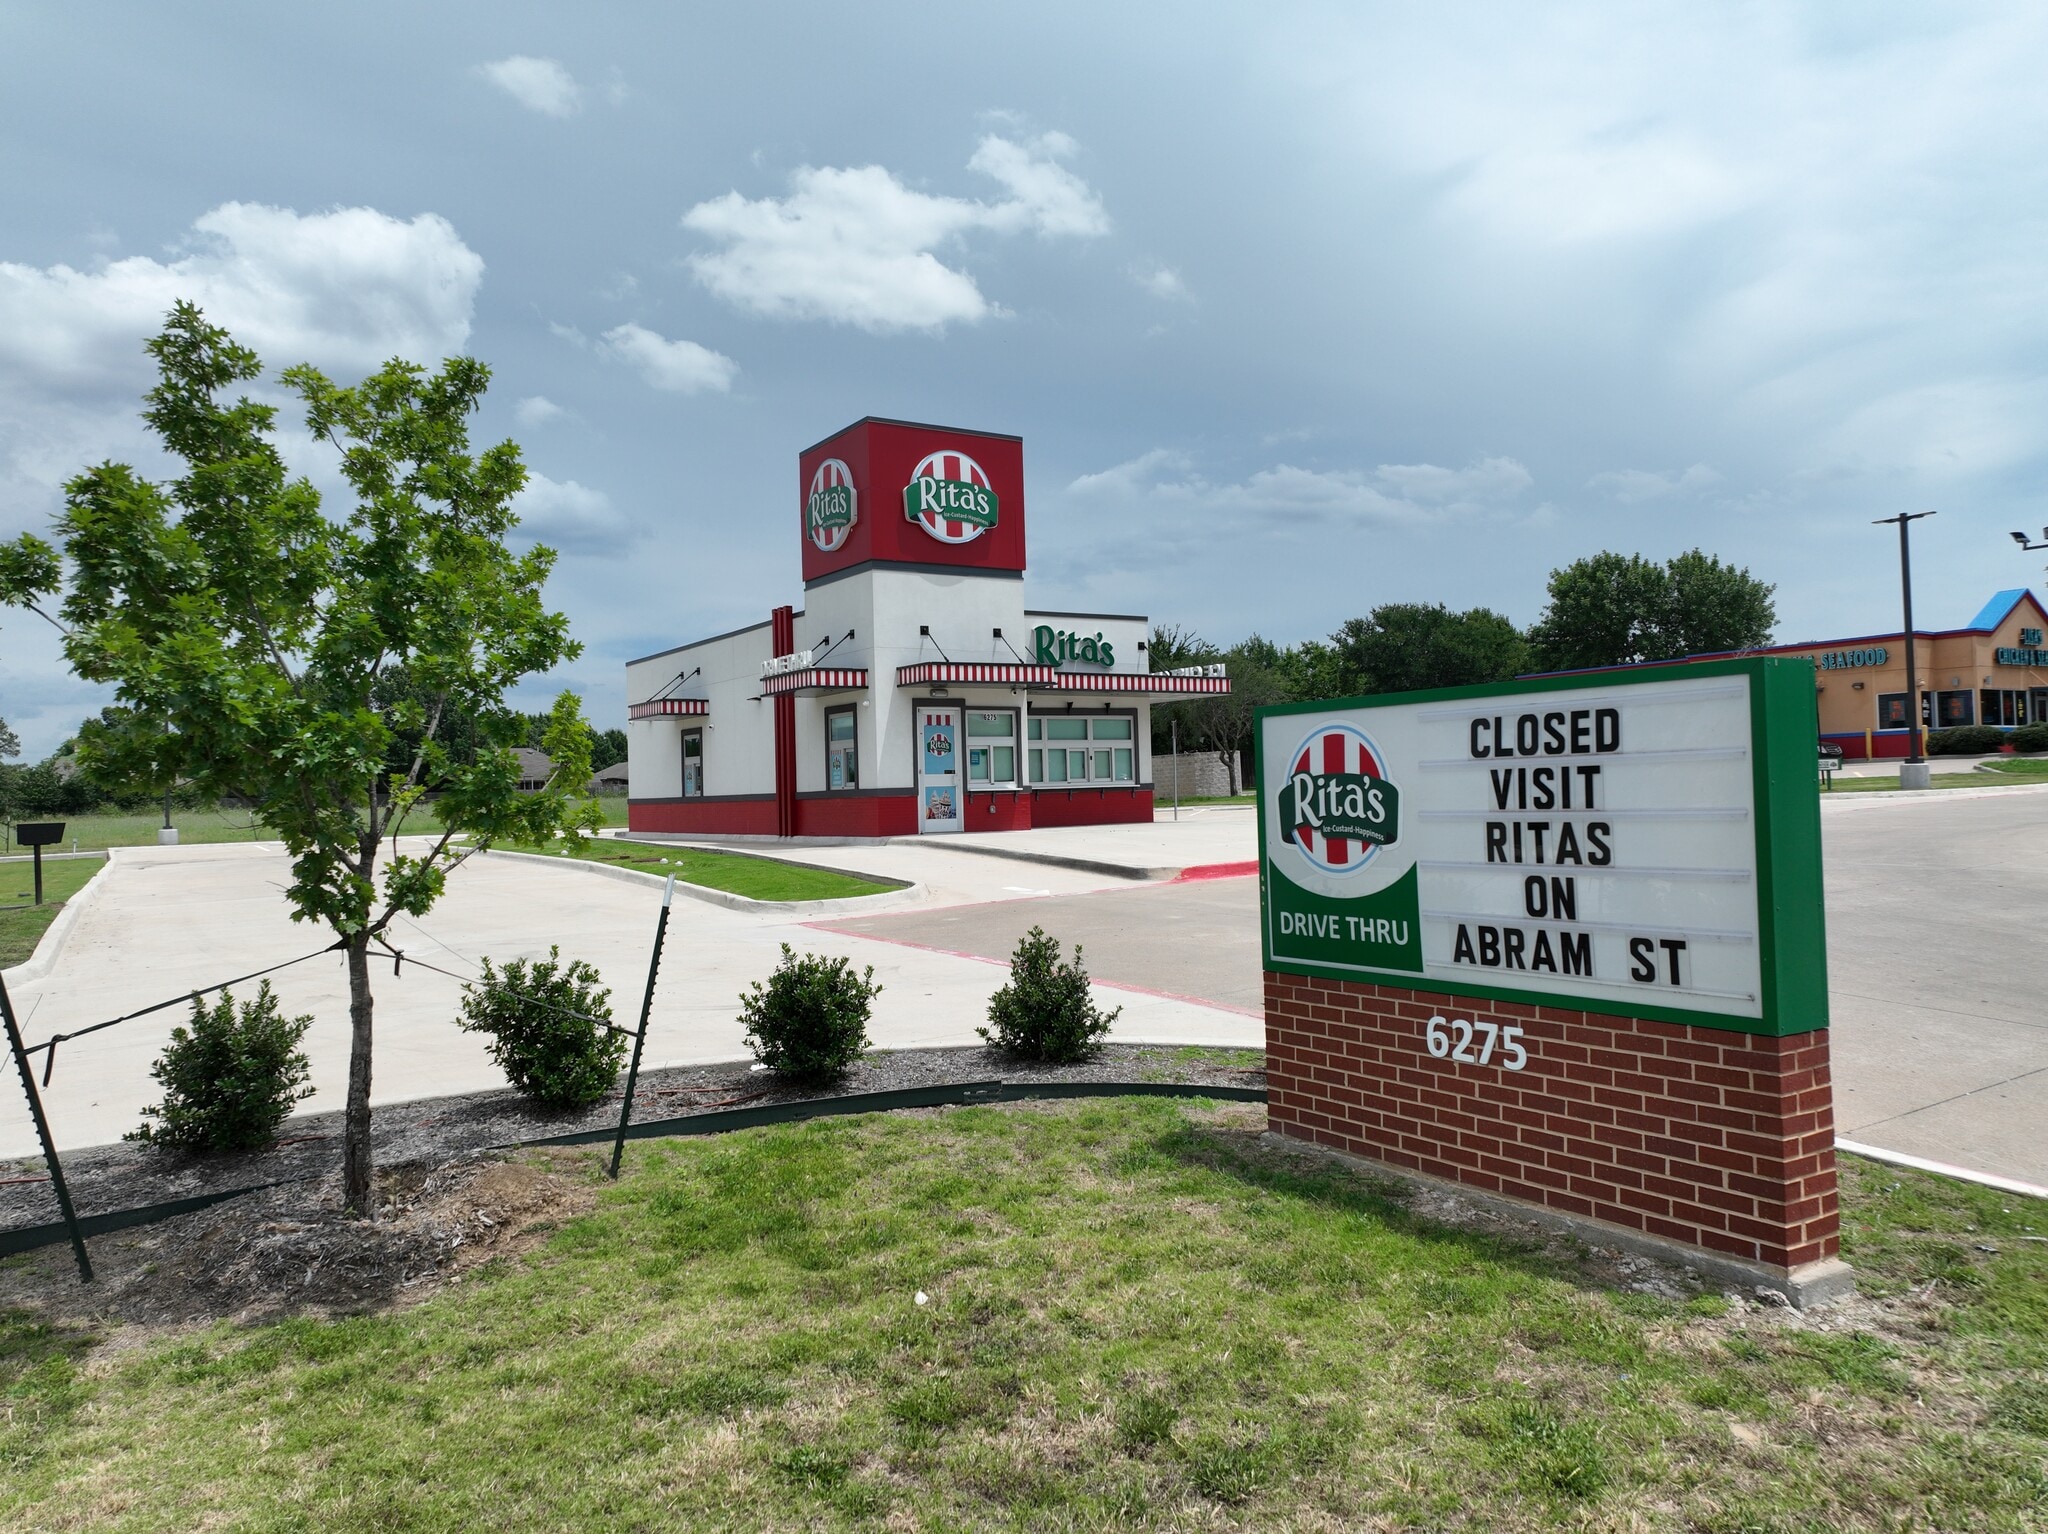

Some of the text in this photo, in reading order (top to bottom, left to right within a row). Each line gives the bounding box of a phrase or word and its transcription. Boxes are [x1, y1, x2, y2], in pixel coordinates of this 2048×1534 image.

[811, 485, 847, 527] Rita's
[919, 476, 990, 515] Rita's
[1034, 624, 1115, 667] Rita's
[1821, 647, 1887, 671] SEAFOOD
[983, 713, 997, 721] 6275
[1470, 707, 1620, 758] CLOSED
[930, 739, 950, 750] Rita's
[1292, 773, 1386, 828] Rita's
[1490, 765, 1602, 811] VISIT
[1486, 821, 1611, 866] RITAS
[1524, 875, 1577, 920] ON
[1280, 911, 1409, 946] DRIVE THRU
[1454, 924, 1687, 987] ABRAM ST
[1426, 1015, 1528, 1071] 6275
